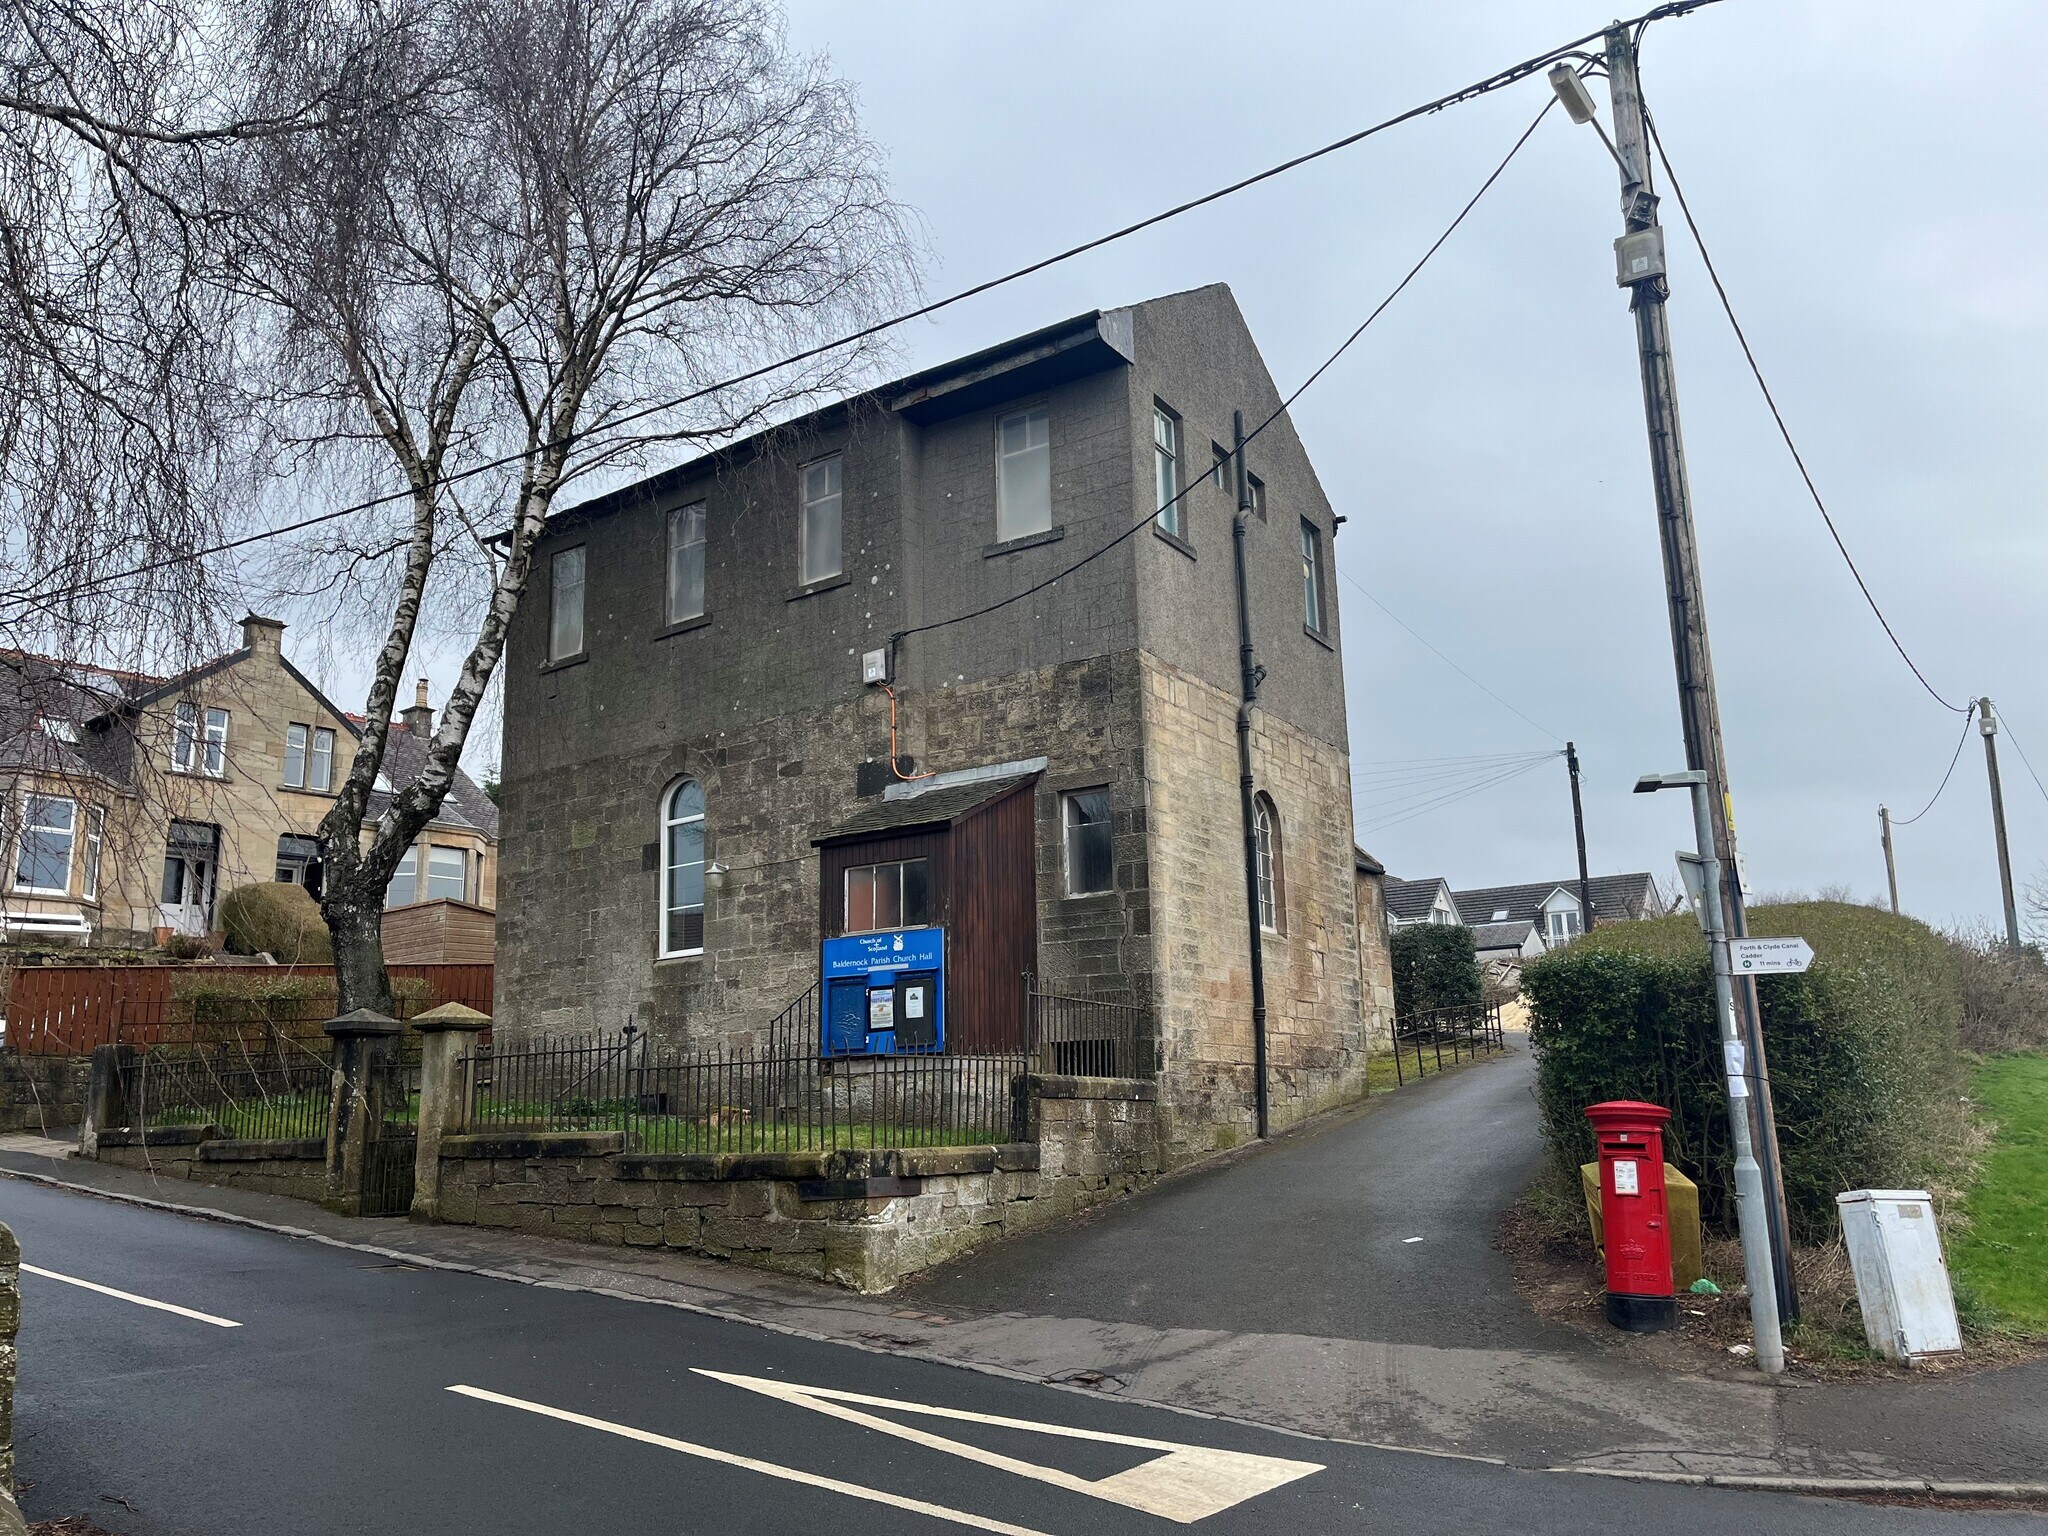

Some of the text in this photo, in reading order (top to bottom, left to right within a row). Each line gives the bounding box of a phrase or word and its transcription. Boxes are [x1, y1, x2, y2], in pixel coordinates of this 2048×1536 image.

[833, 952, 932, 968] Baldernock Parish Church Hall
